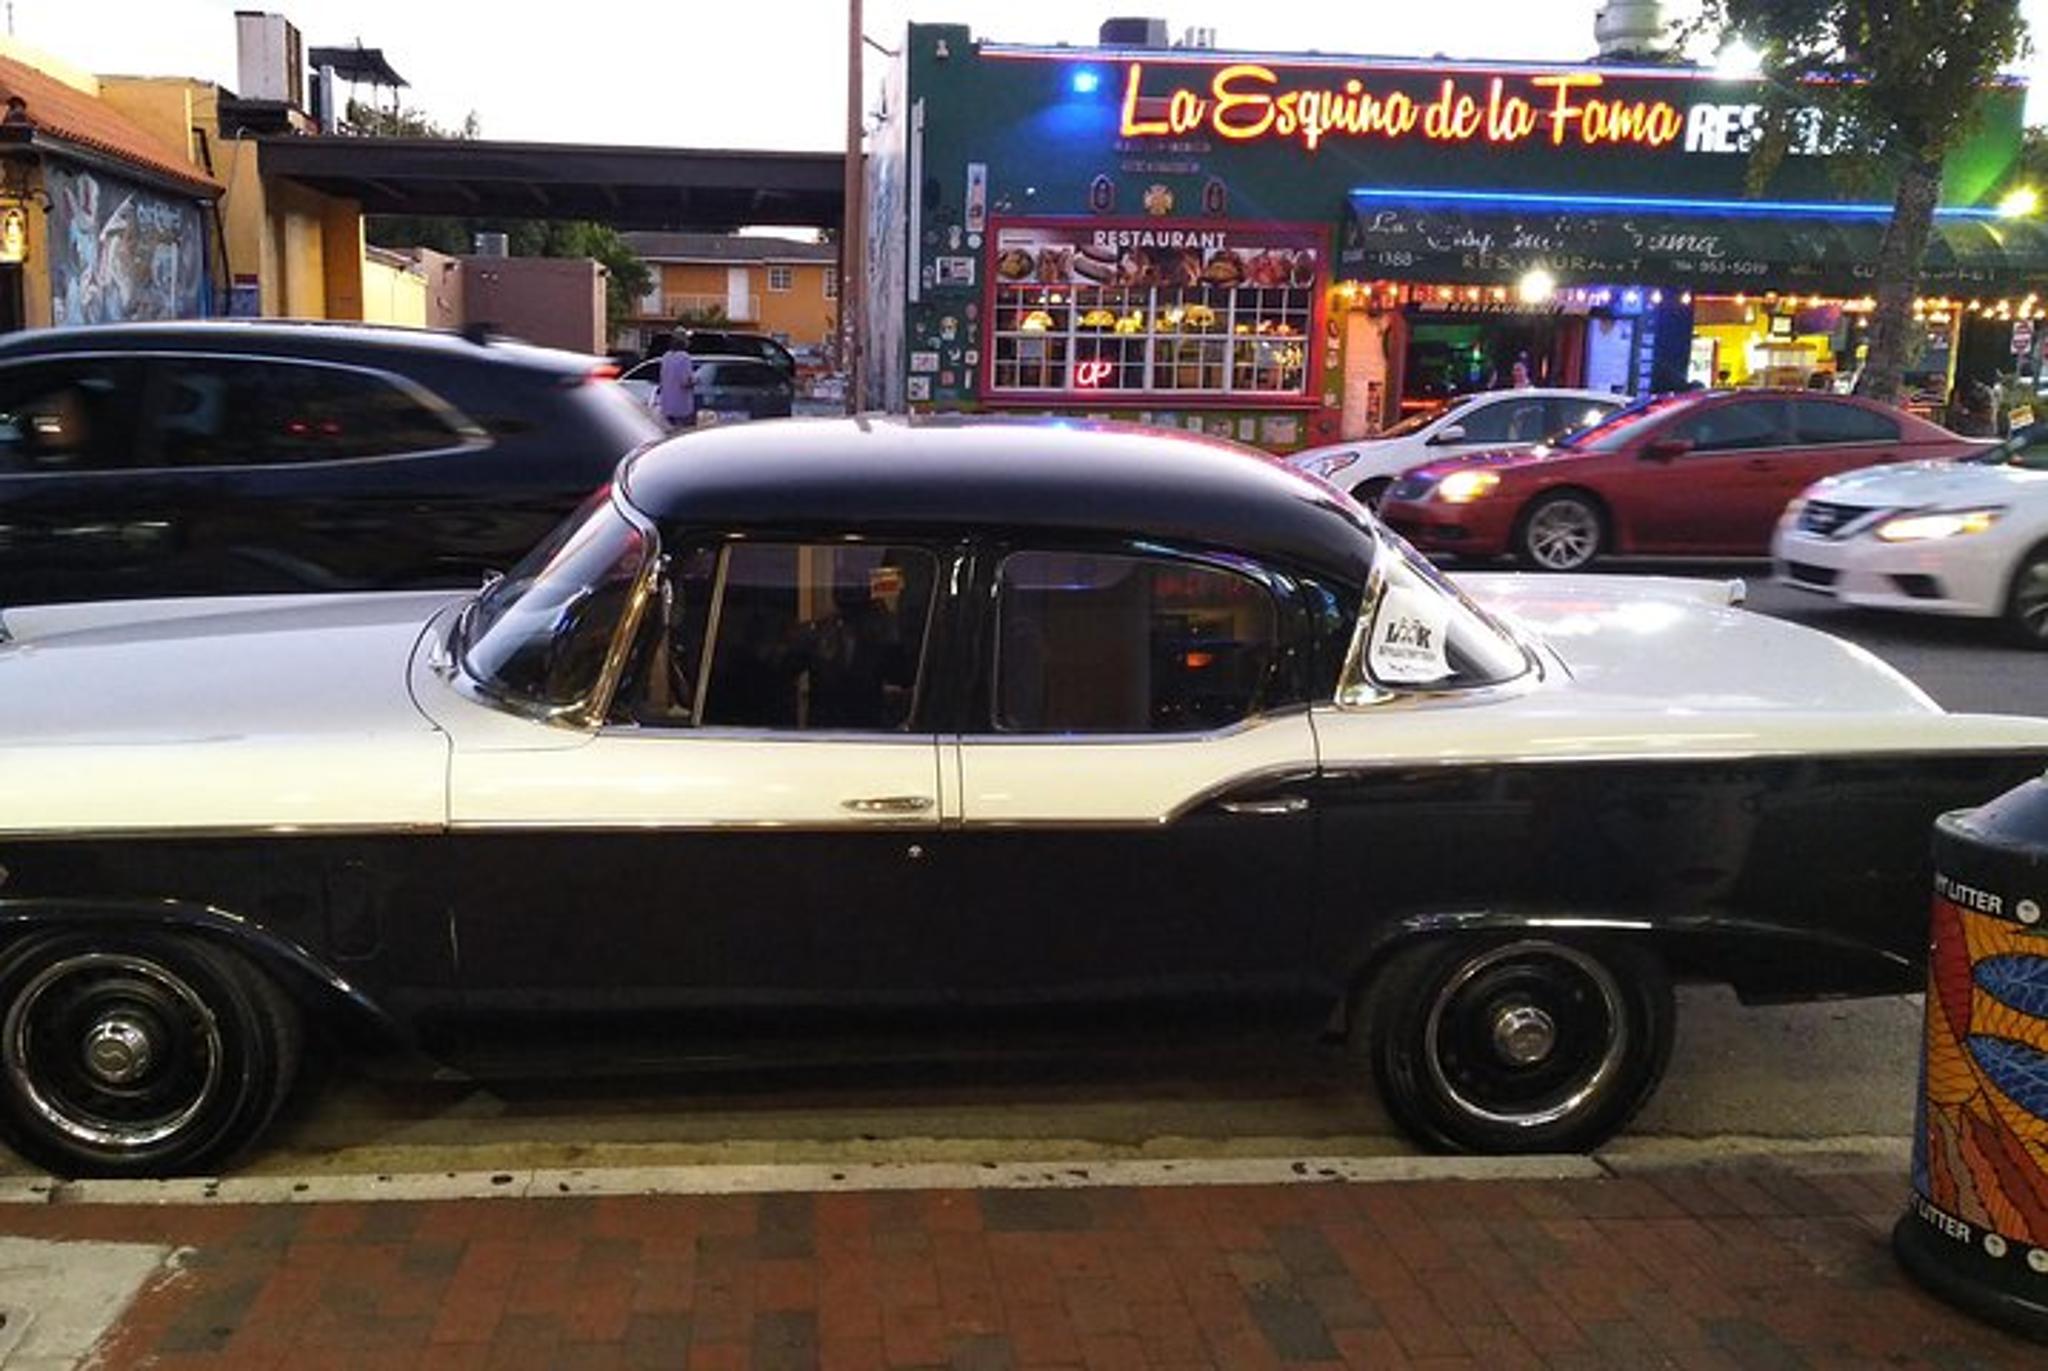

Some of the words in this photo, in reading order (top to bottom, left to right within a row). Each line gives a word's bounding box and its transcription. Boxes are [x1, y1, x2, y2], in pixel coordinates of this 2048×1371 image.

[1120, 61, 1204, 138] La
[1211, 63, 1416, 150] Esquina
[1424, 79, 1481, 141] de
[1487, 76, 1538, 143] la
[1531, 72, 1682, 145] Fama
[1093, 230, 1226, 248] RESTAURANT
[1948, 881, 2003, 914] LITTER
